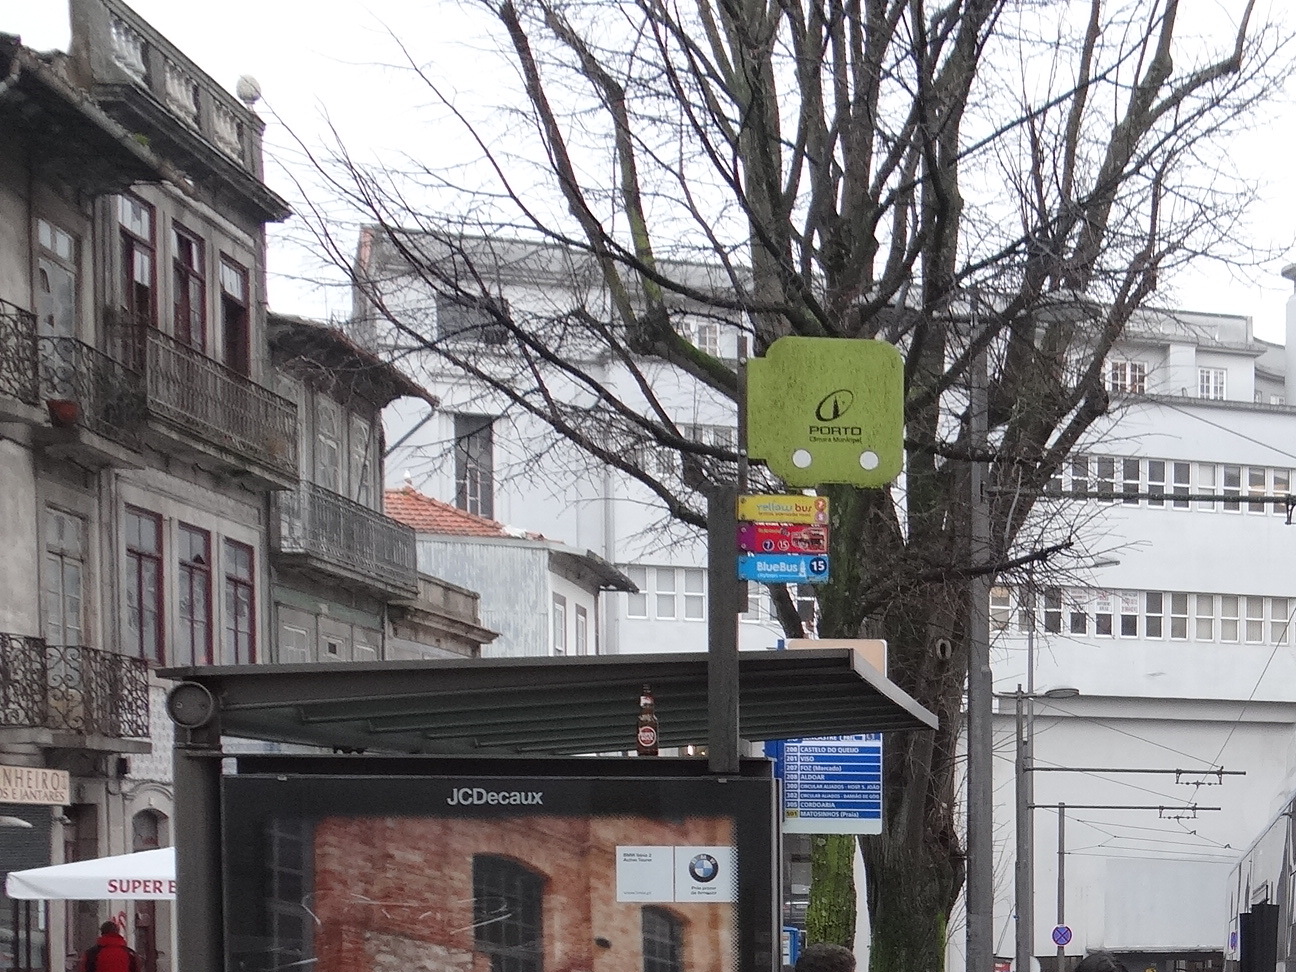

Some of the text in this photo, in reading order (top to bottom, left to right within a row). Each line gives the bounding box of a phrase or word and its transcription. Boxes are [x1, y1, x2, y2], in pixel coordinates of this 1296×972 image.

[809, 425, 862, 436] PORTO
[794, 503, 813, 513] bus
[779, 540, 788, 550] 15
[756, 561, 798, 573] BlueBus
[811, 561, 825, 573] 15
[800, 746, 826, 754] CASTELO
[827, 746, 837, 754] DO
[838, 746, 860, 754] QUEIJO
[446, 788, 544, 805] JCDecaux
[800, 811, 840, 819] MATOSINHOS
[107, 879, 163, 894] SUPER
